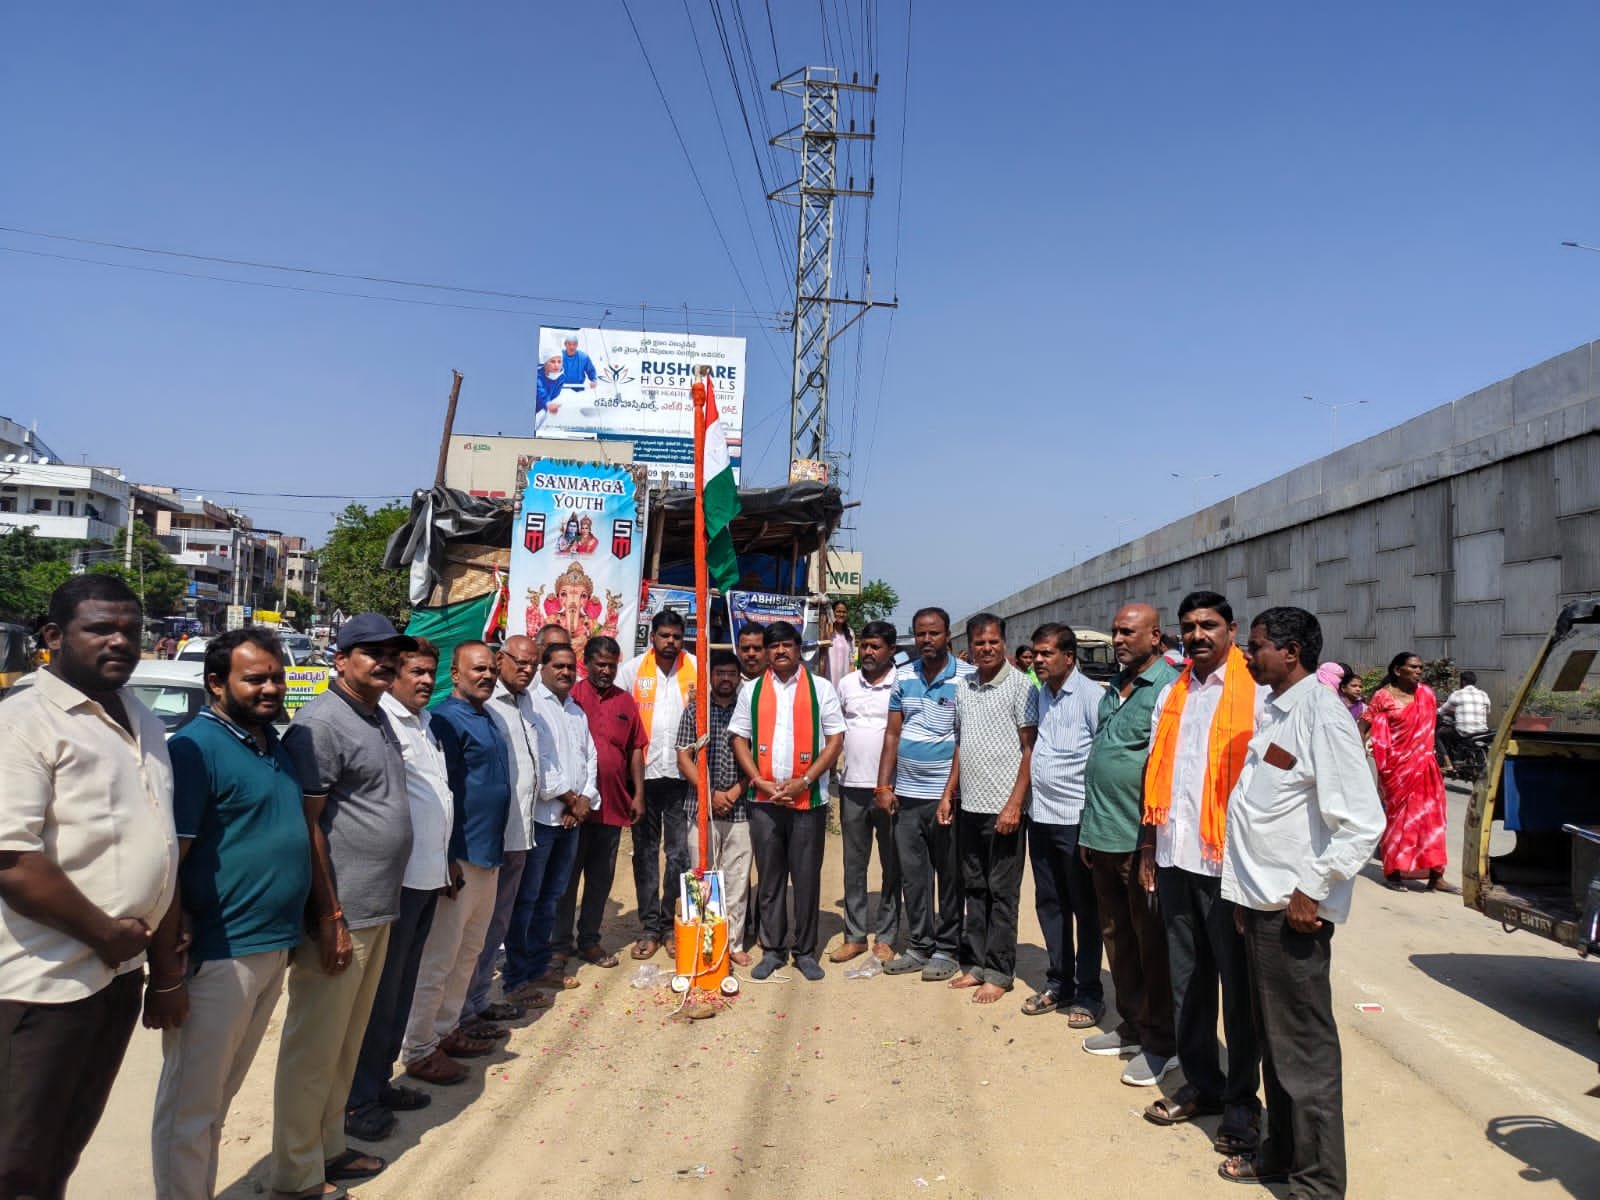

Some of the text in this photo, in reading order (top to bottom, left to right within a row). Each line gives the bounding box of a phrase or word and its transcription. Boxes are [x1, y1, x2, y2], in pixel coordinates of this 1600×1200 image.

[640, 375, 736, 390] HOSPILS
[535, 474, 625, 494] SANMARGA
[554, 493, 604, 511] YOUTH
[825, 571, 859, 585] IME
